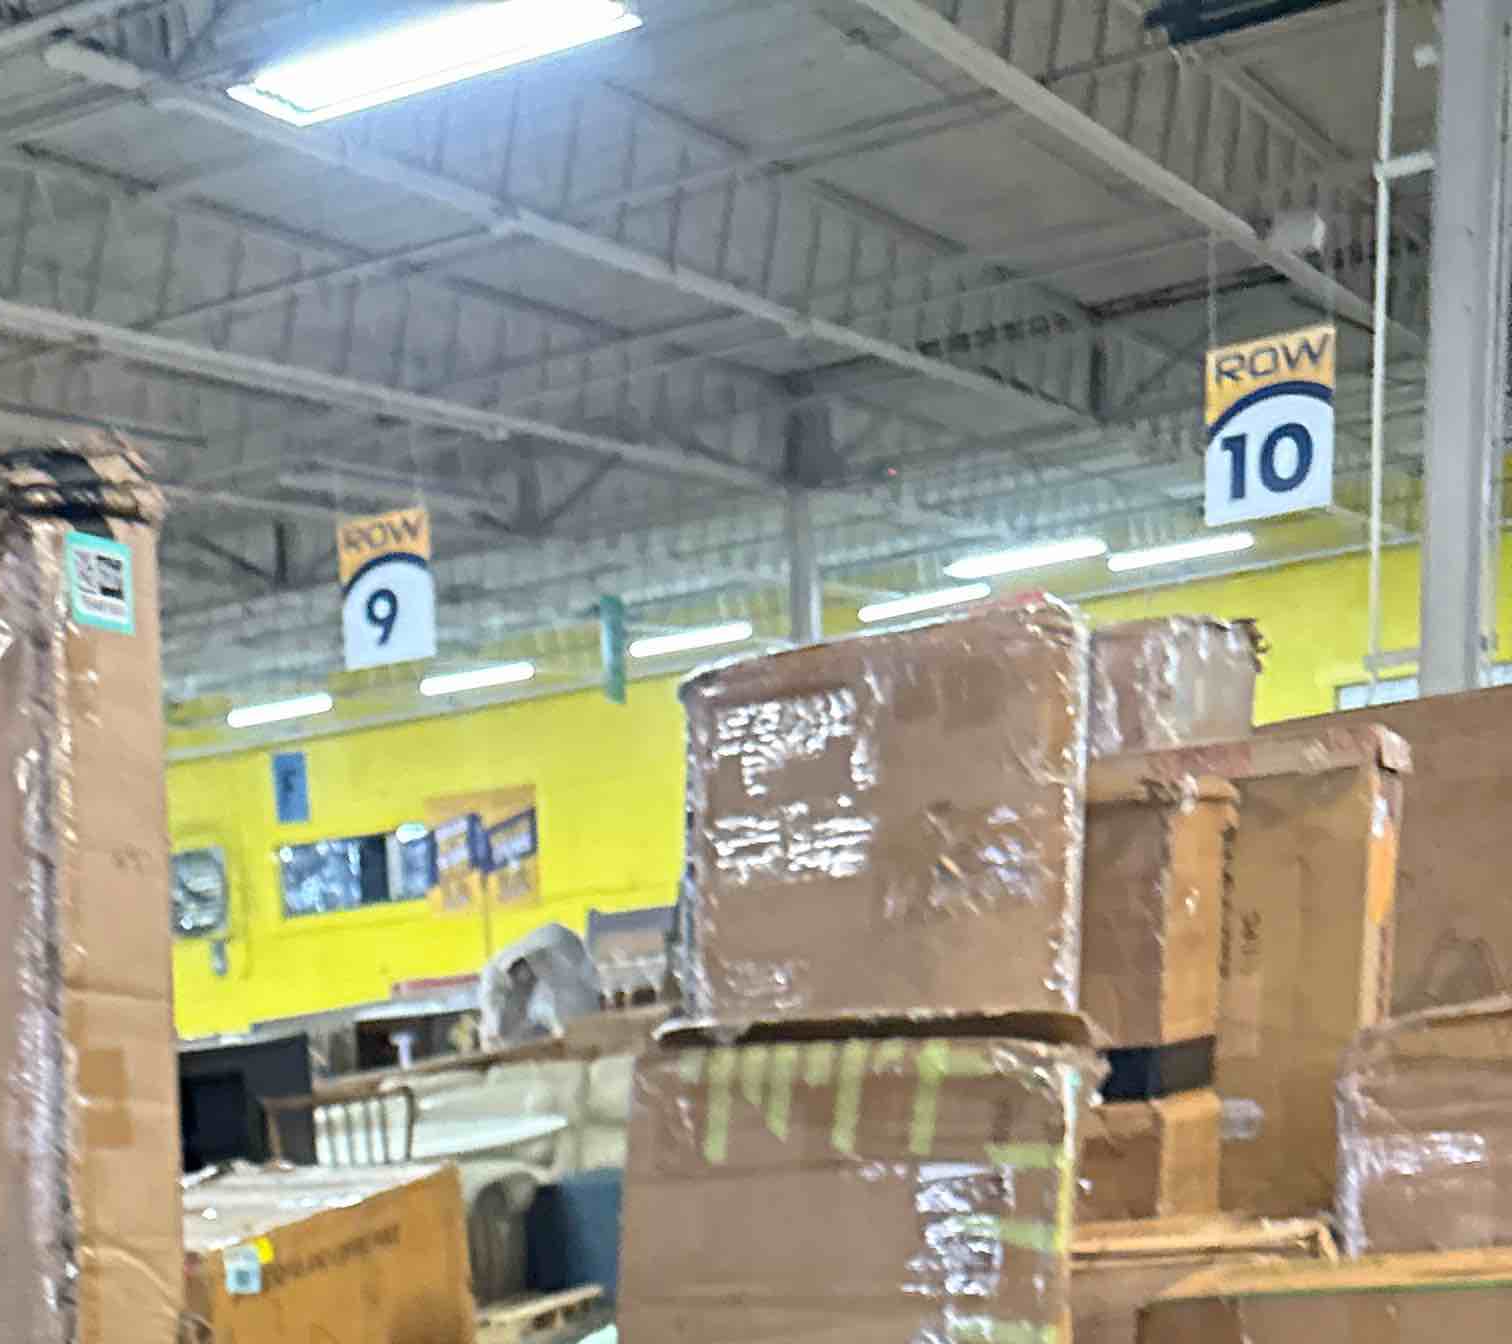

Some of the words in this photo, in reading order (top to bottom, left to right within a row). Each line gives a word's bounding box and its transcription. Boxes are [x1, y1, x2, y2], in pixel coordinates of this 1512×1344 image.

[1216, 332, 1331, 386] ROW
[1220, 422, 1314, 500] 10
[342, 513, 426, 552] ROW
[365, 588, 399, 647] 9
